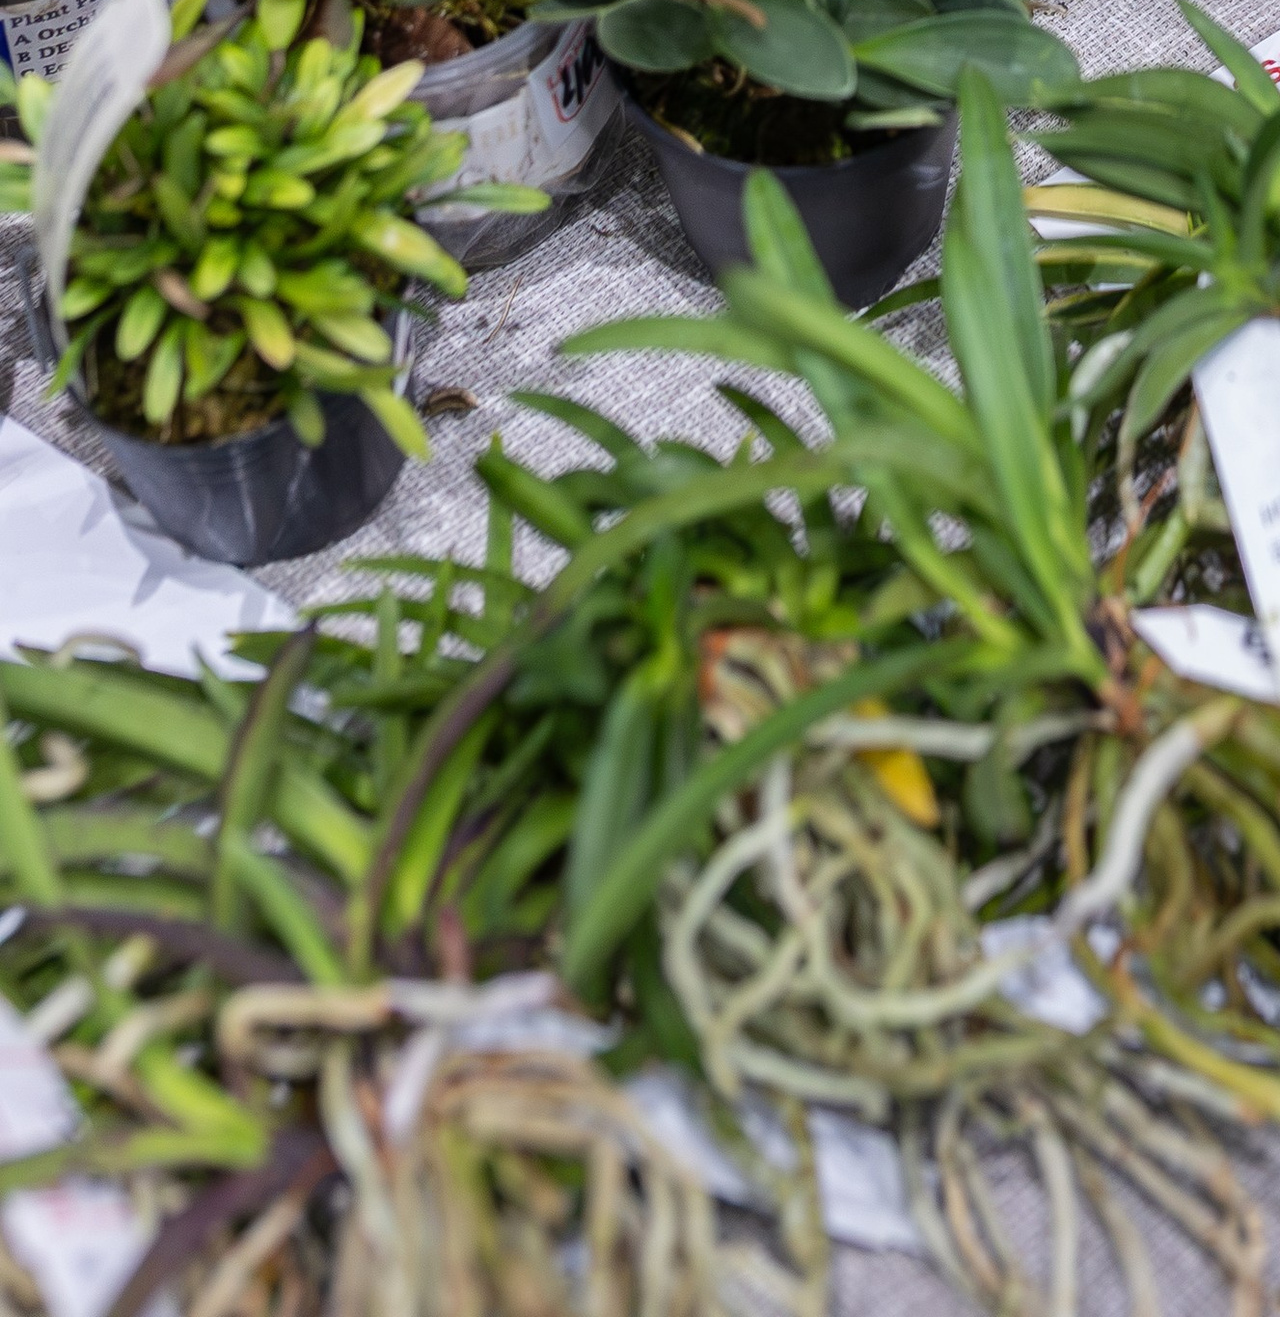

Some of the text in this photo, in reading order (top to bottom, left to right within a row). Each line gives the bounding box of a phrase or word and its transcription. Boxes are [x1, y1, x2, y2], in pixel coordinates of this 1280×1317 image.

[10, 4, 71, 29] Plant
[14, 34, 31, 47] A
[16, 51, 31, 64] B
